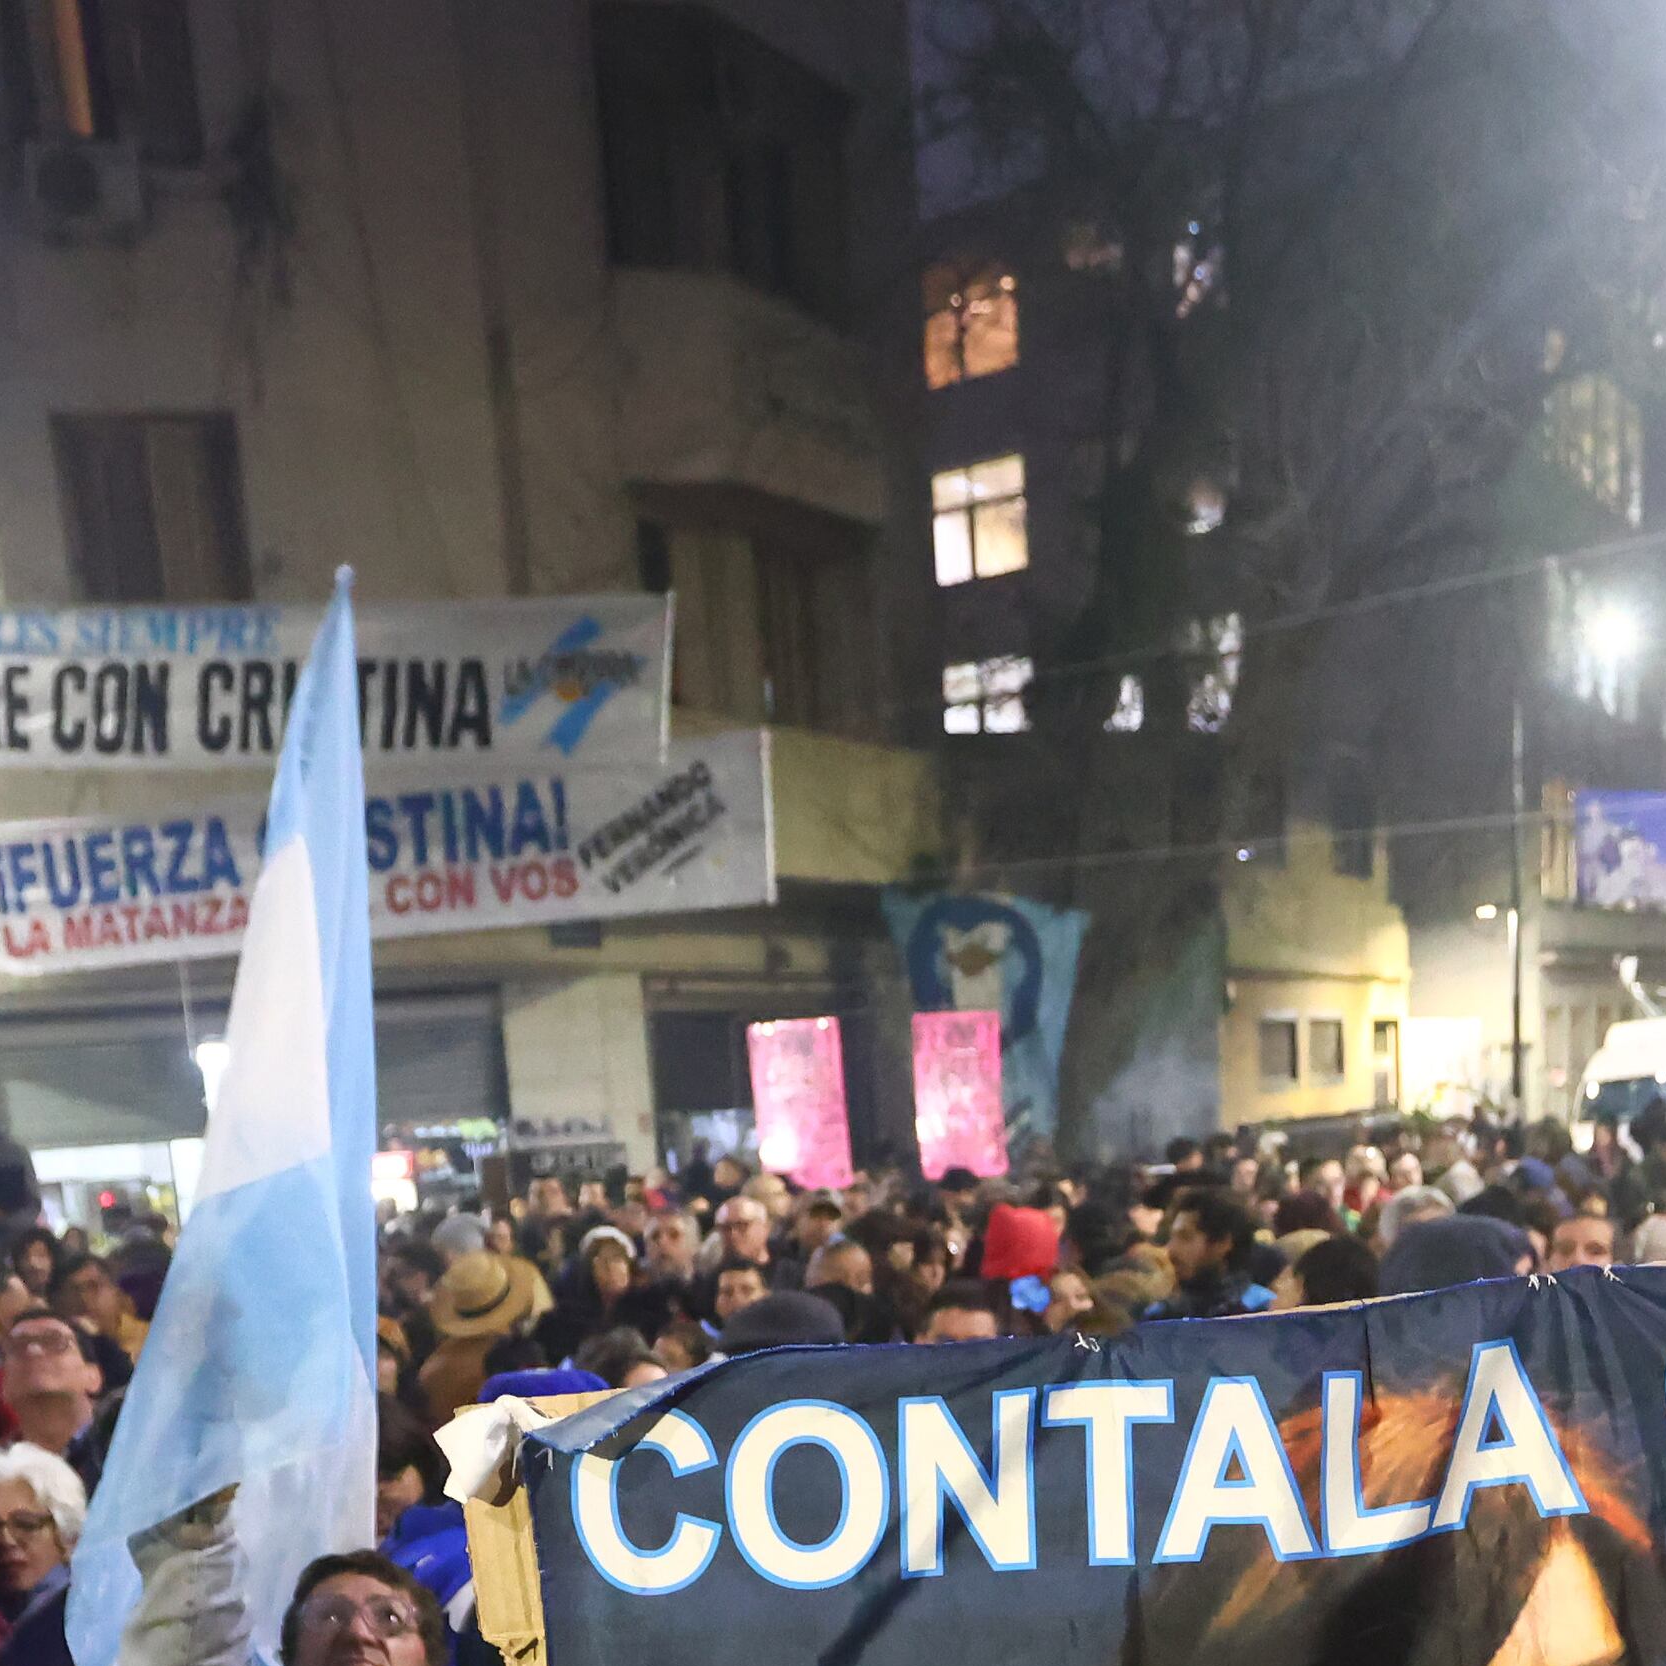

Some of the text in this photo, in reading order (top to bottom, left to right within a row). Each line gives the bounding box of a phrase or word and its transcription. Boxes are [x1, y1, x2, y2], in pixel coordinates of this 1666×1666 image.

[51, 661, 171, 753] CON
[196, 657, 492, 752] CRITINA
[3, 857, 580, 958] LA MATANZA CON VOS
[571, 1337, 1591, 1597] CONTALA
